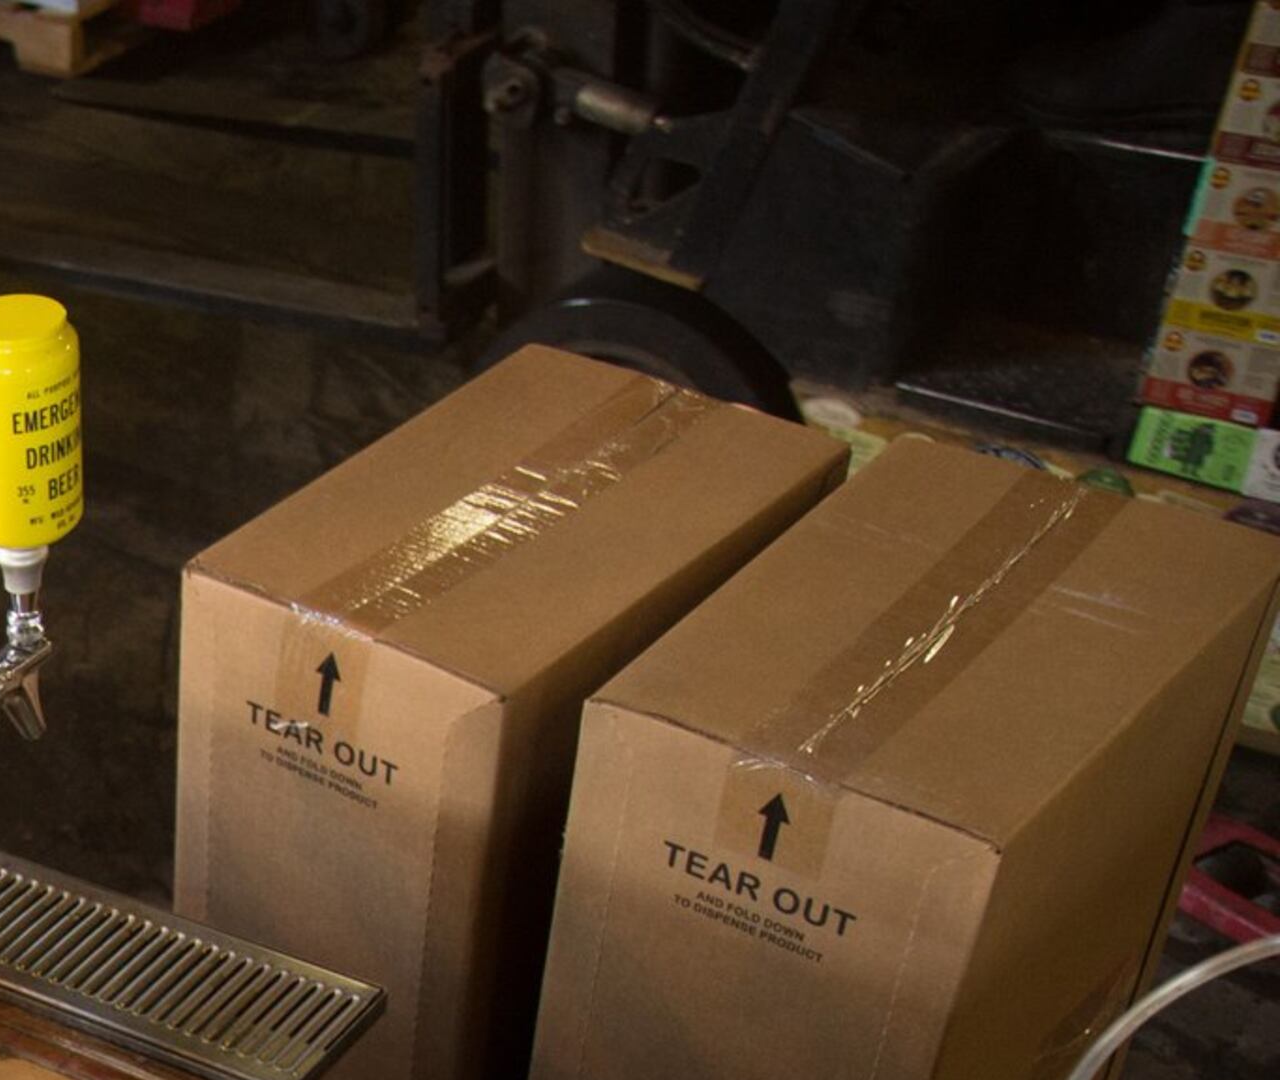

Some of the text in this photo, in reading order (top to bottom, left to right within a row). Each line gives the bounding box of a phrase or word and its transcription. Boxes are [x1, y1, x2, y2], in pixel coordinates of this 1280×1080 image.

[246, 700, 400, 785] TEAR OUT
[260, 748, 275, 763] TO
[327, 779, 379, 808] PRODUCT
[663, 839, 858, 937] TEAR OUT
[696, 890, 807, 943] AND FOLD DOWN
[673, 893, 824, 964] TO DISPENSE PRODUCT
